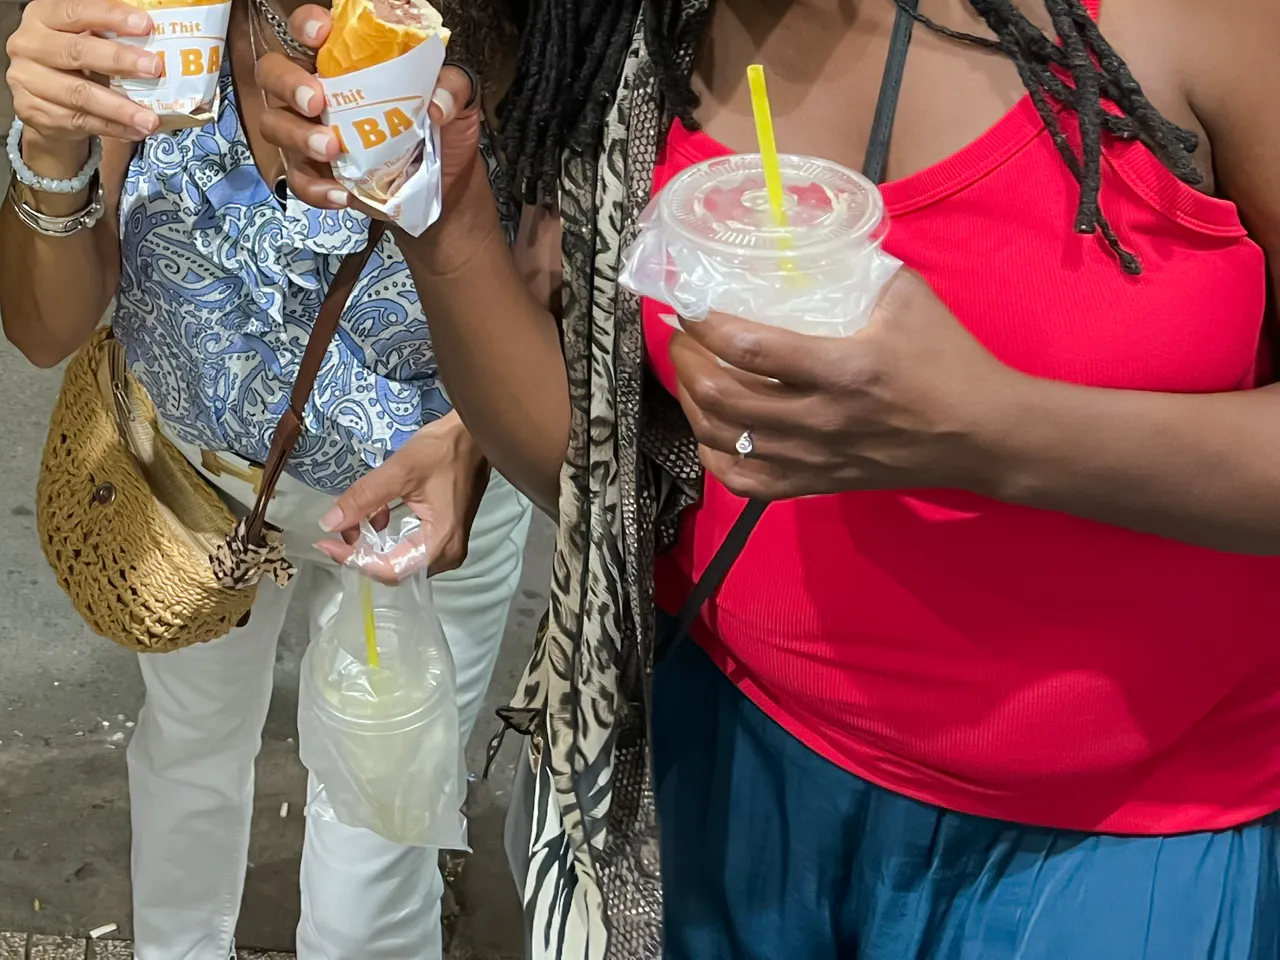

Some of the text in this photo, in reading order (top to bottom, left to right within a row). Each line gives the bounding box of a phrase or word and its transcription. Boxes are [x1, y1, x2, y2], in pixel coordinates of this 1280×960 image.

[169, 20, 202, 36] Thịt
[331, 87, 366, 106] Thịt
[352, 106, 415, 150] BA
